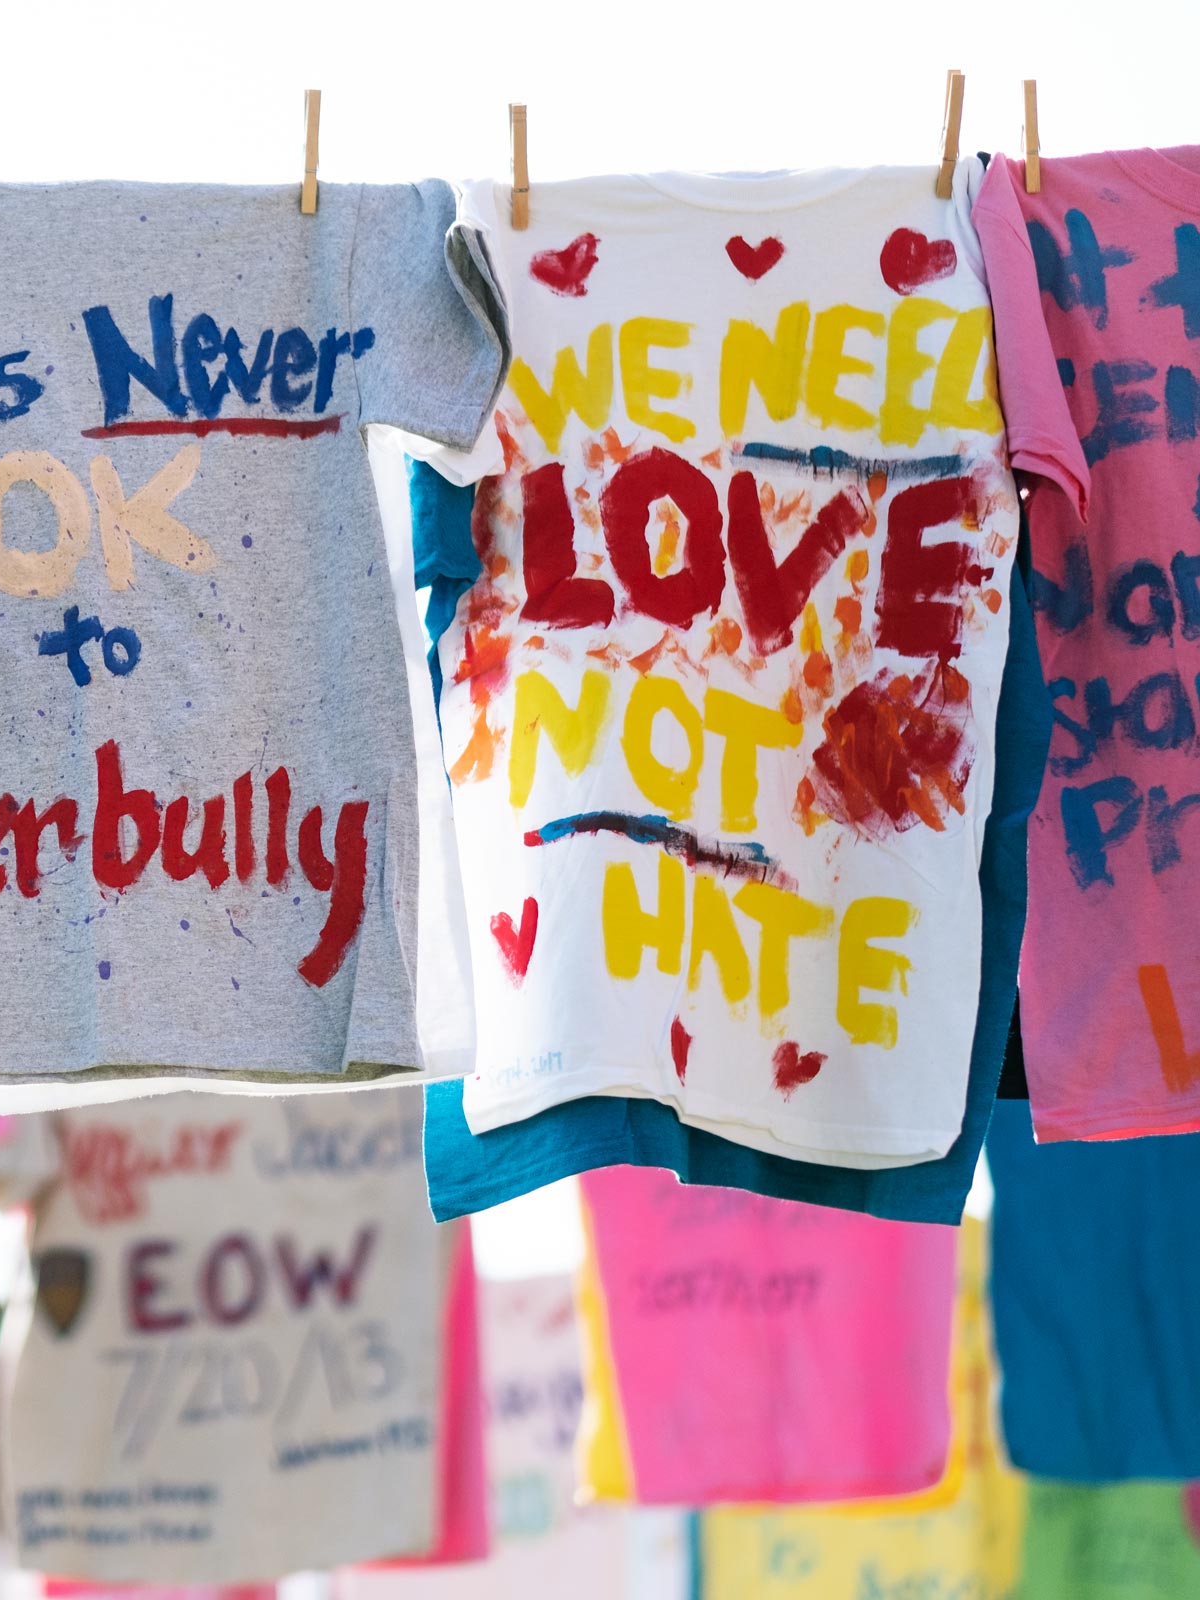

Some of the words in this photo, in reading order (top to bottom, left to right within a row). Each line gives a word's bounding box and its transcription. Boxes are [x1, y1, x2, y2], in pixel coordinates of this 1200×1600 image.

[82, 293, 375, 426] Never
[506, 323, 697, 454] WE
[718, 297, 1005, 448] NEED
[518, 446, 994, 658] LOVE
[38, 605, 142, 687] to
[507, 669, 802, 833] NOT
[601, 853, 920, 1049] HATE
[125, 1222, 380, 1336] EOW
